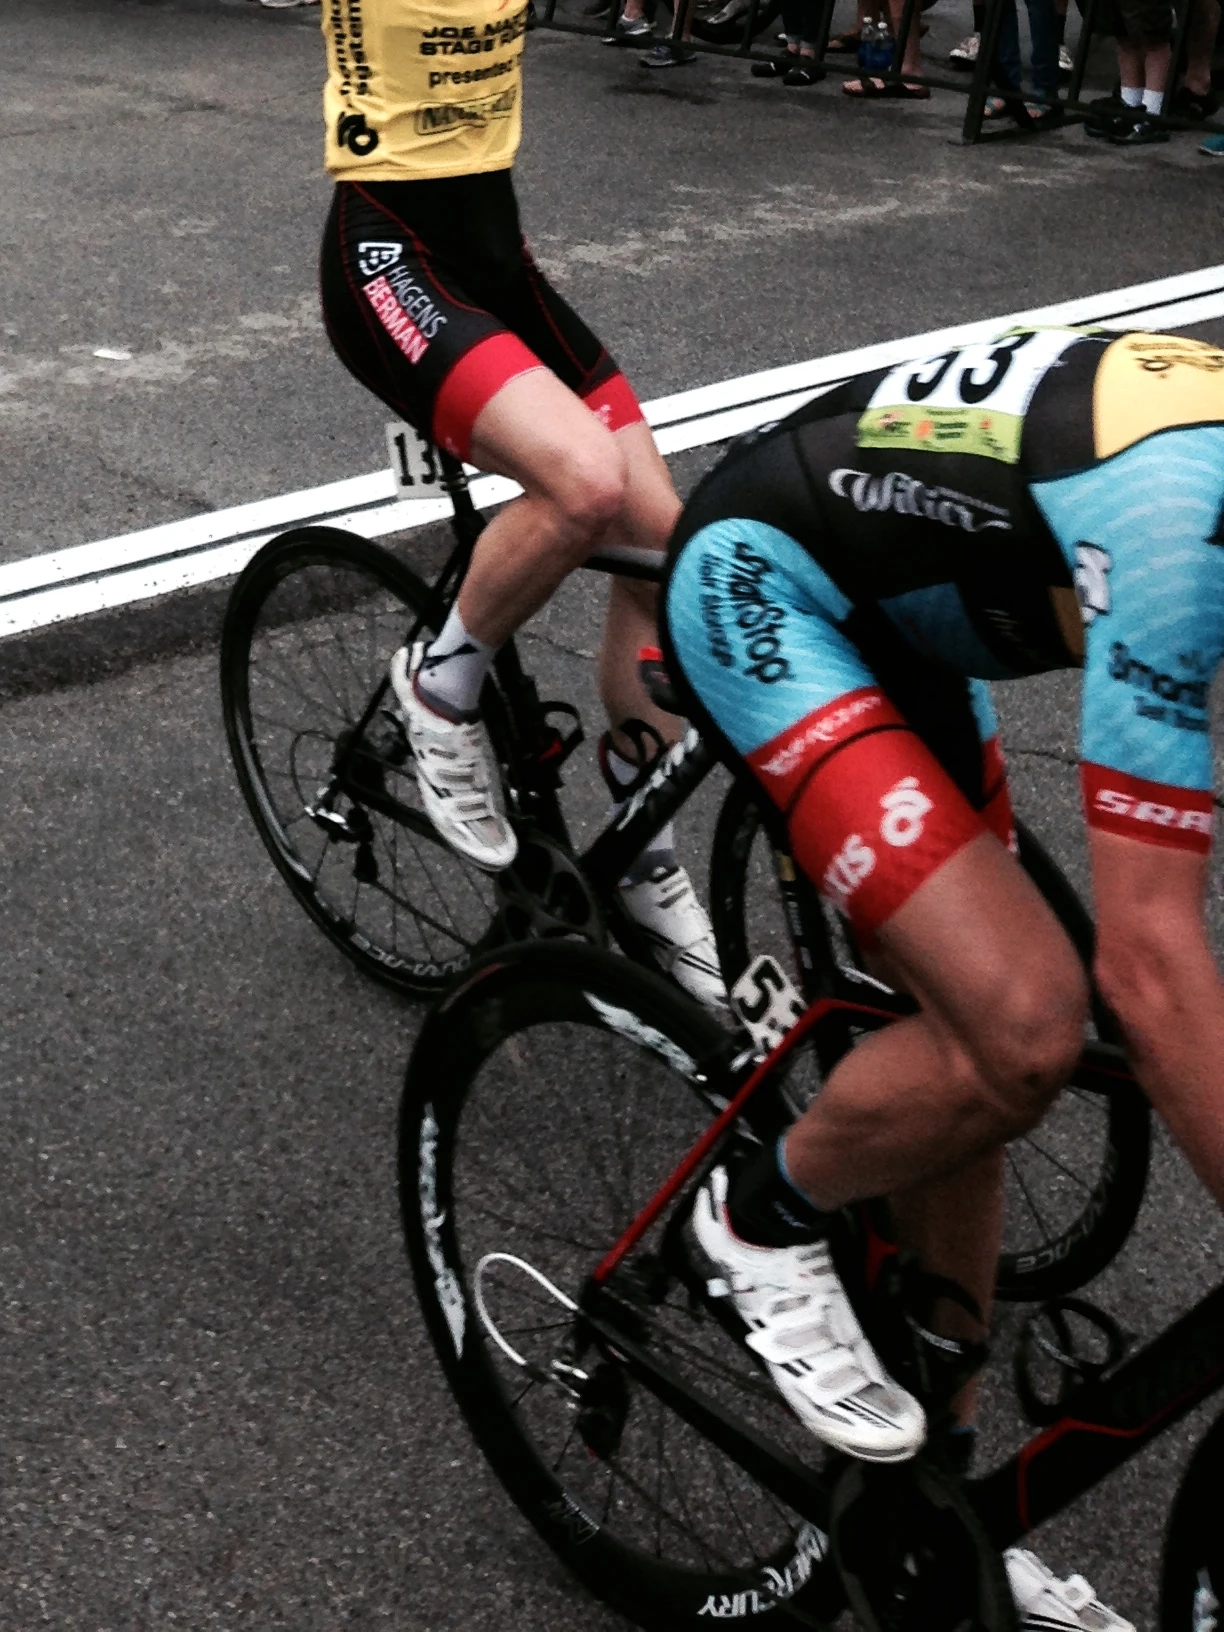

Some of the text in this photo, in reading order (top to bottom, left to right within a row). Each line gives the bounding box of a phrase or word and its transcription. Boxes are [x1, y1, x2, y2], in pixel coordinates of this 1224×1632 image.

[419, 38, 494, 56] STAGE
[423, 26, 476, 39] JOE
[361, 275, 429, 365] BERMAN
[387, 265, 448, 339] HAGENS
